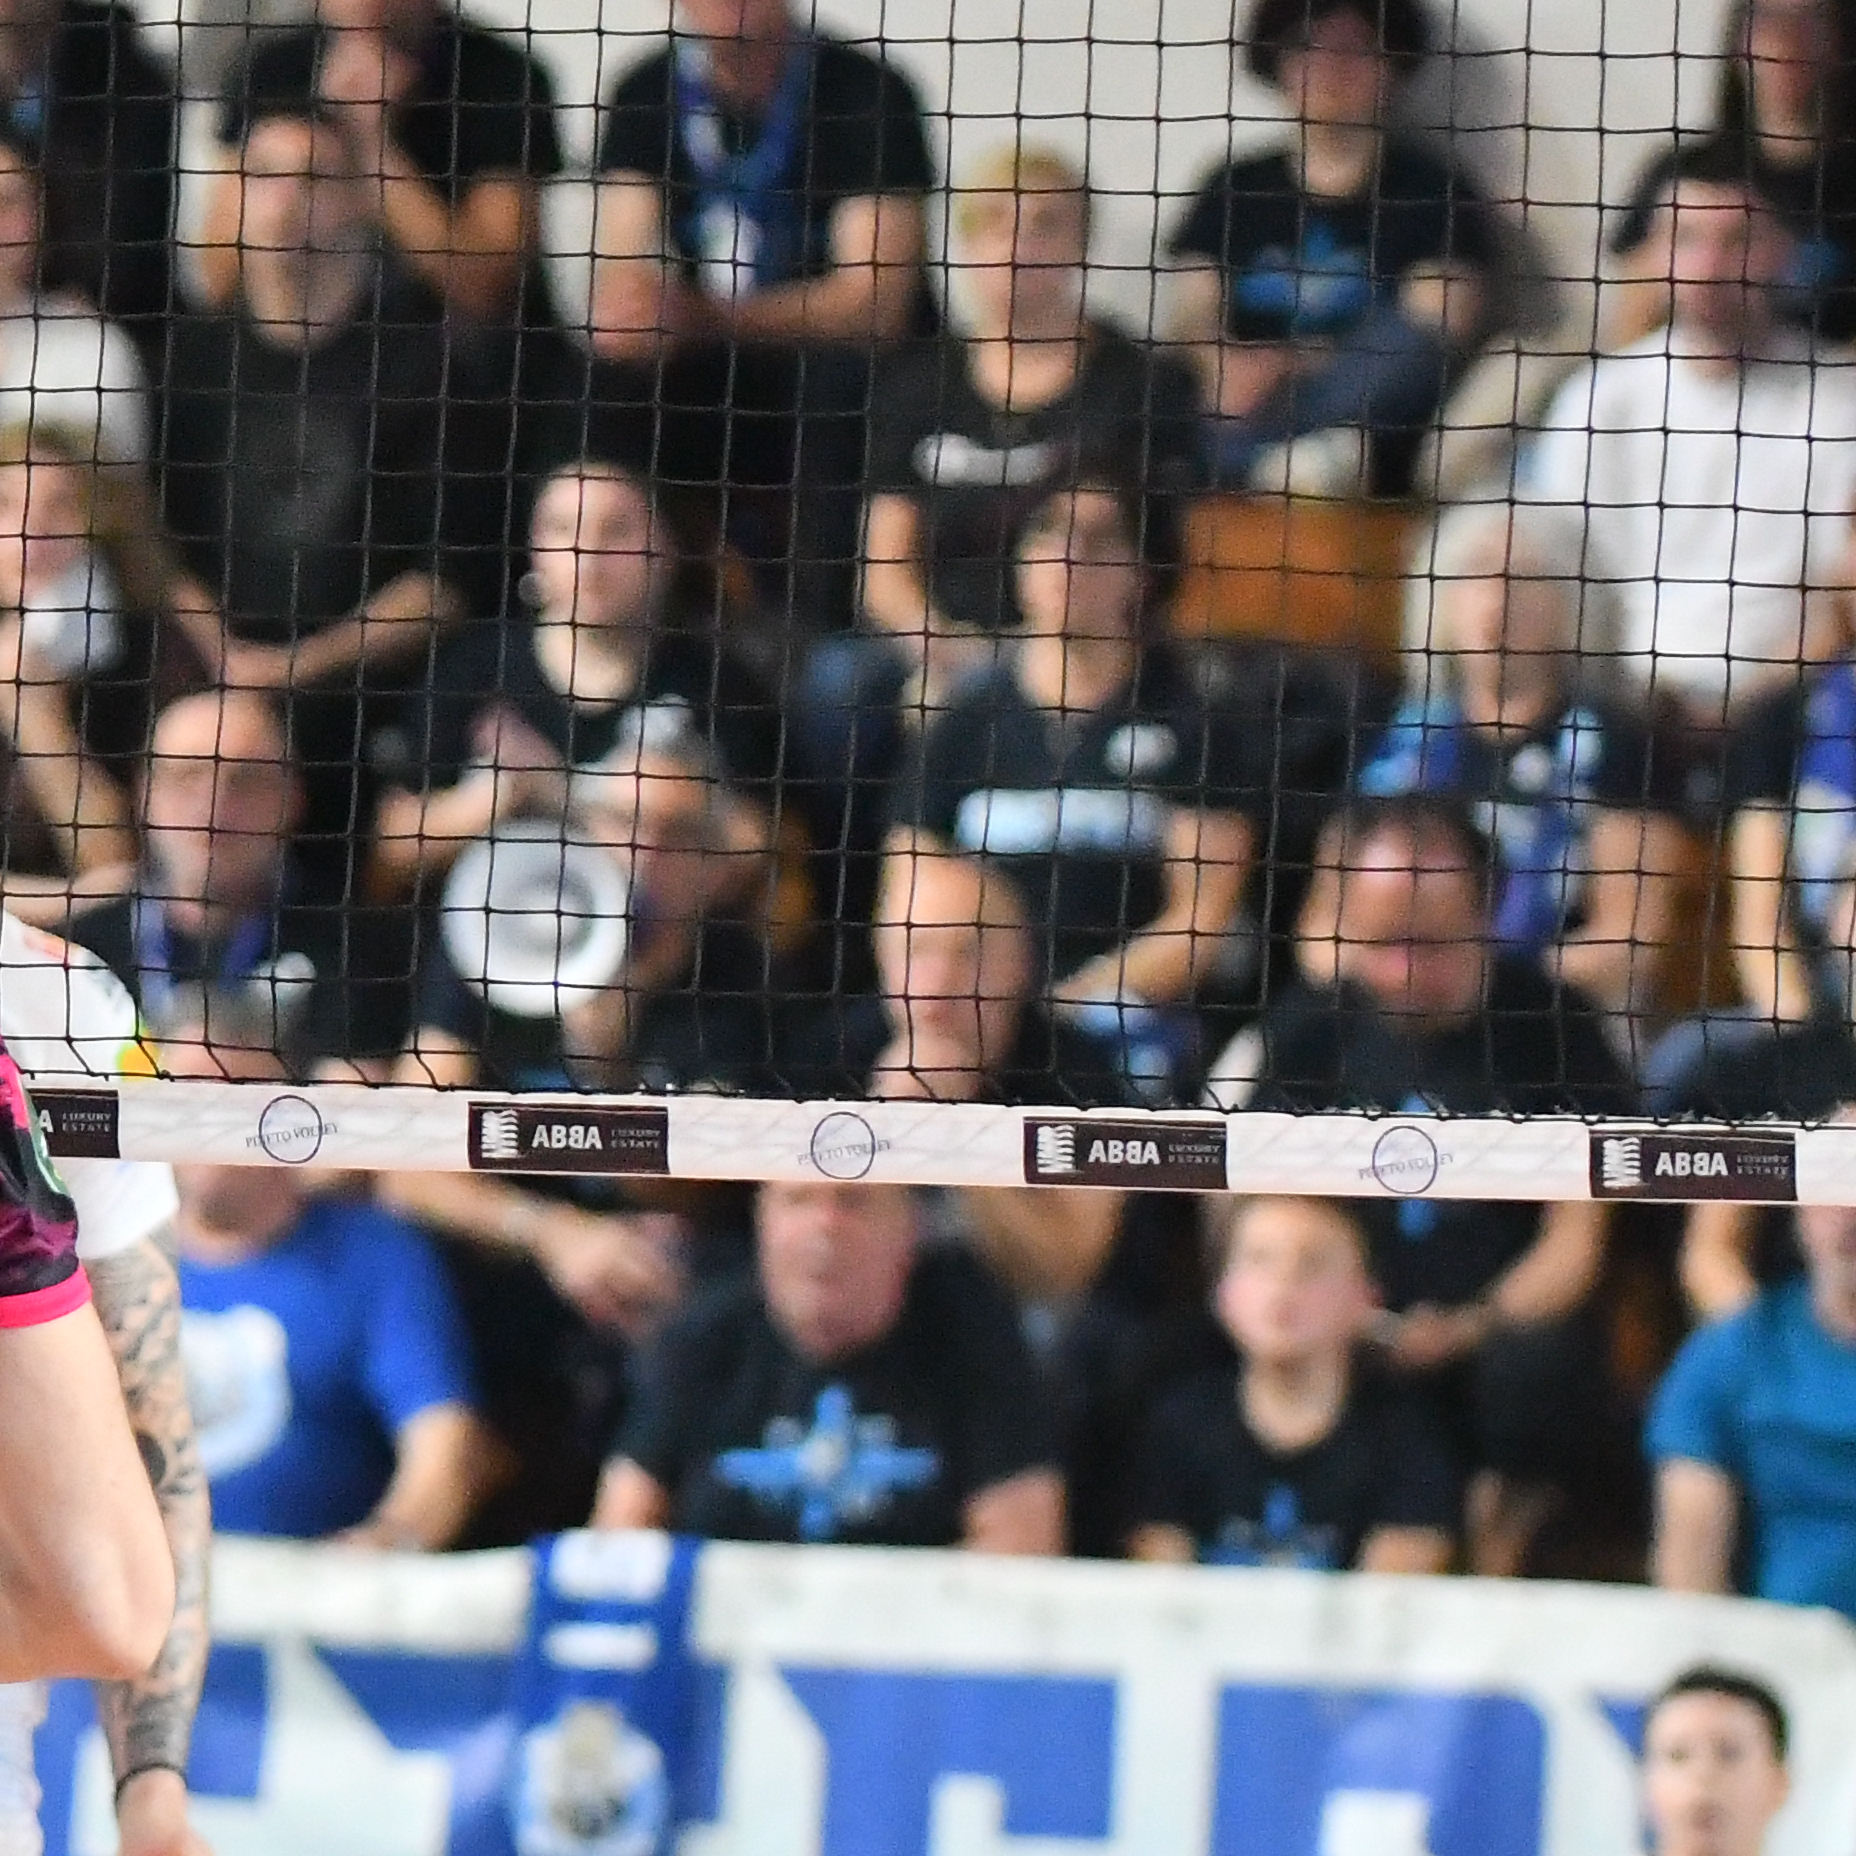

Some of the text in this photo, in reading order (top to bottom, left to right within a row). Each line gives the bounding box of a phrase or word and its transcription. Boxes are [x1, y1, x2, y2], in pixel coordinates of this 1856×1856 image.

[531, 1124, 603, 1150] ABBA
[1088, 1140, 1160, 1164] ABBA
[1655, 1152, 1728, 1176] ABBA
